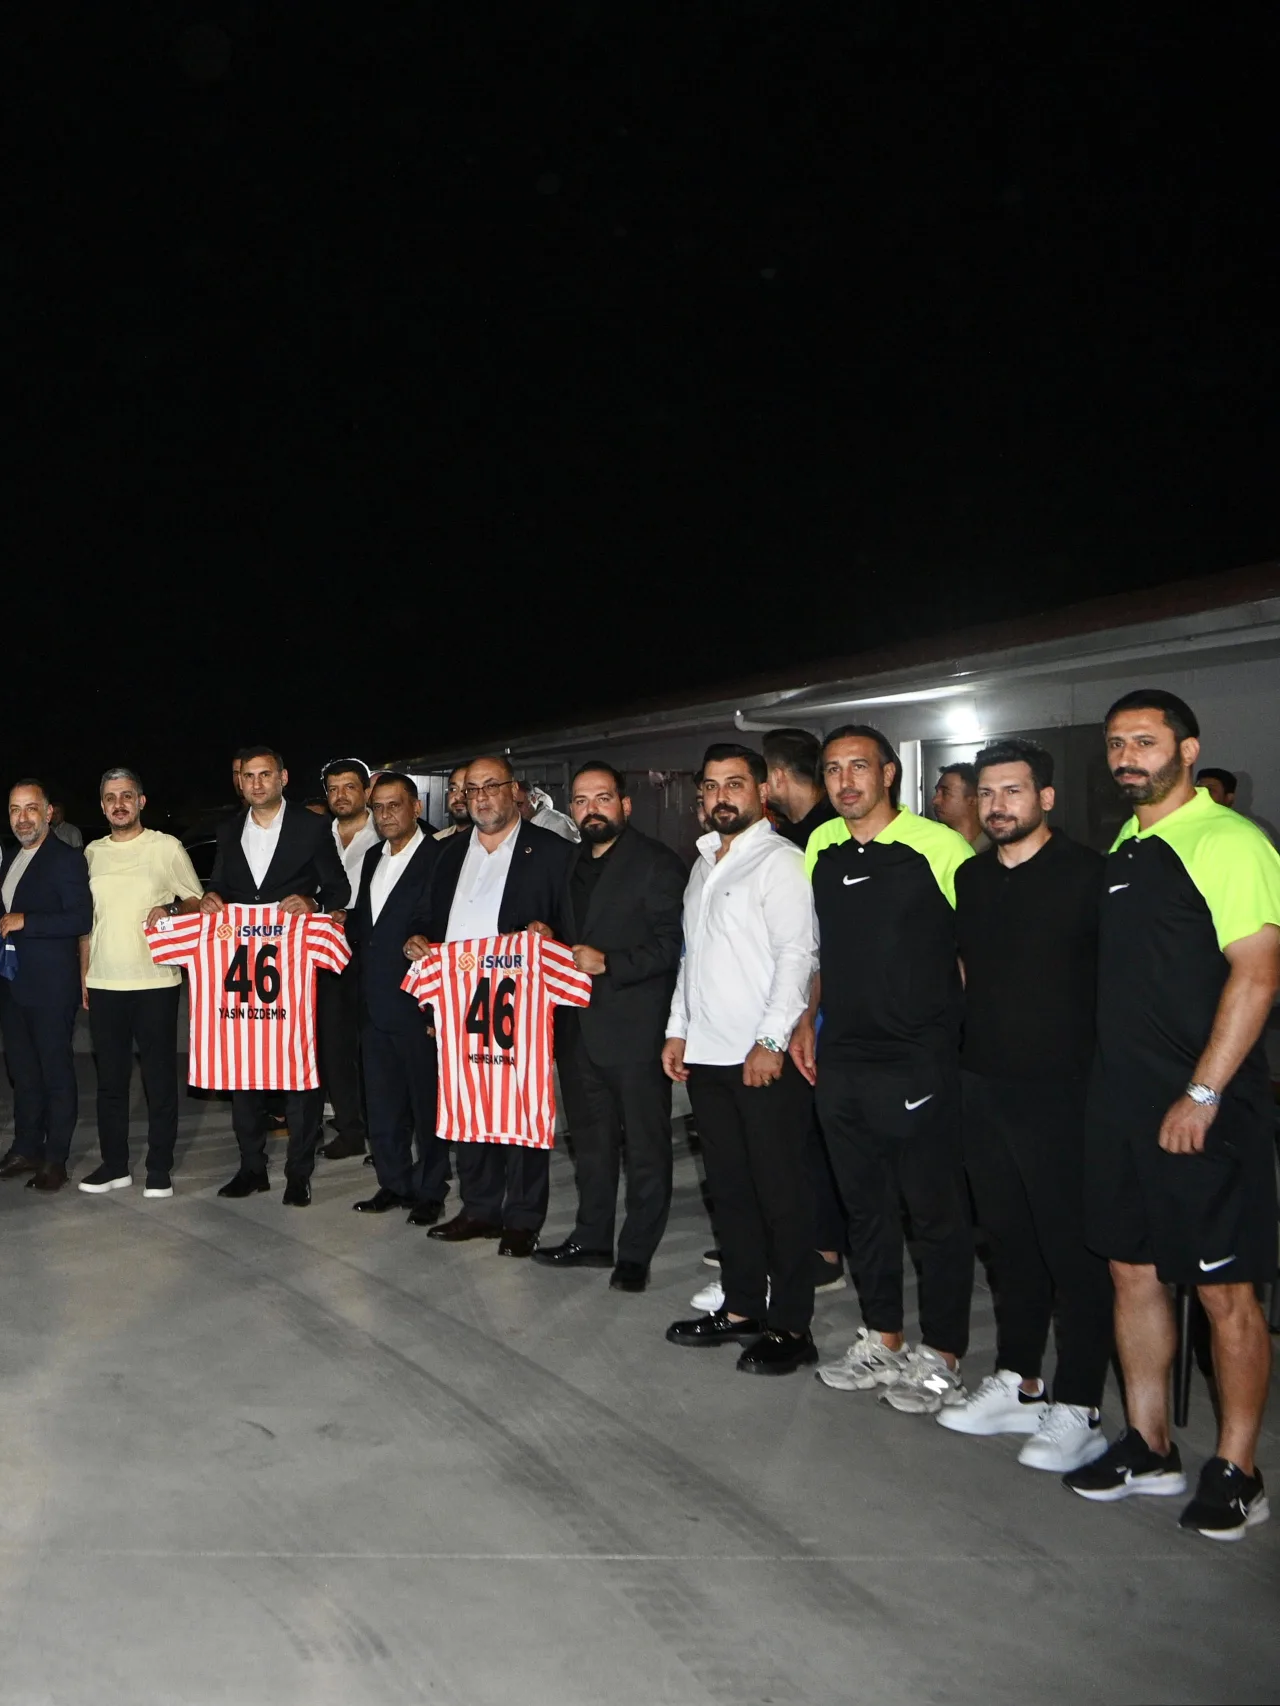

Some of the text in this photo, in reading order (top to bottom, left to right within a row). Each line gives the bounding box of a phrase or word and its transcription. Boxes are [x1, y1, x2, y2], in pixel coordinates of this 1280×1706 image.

[224, 944, 281, 1004] 46
[218, 1005, 287, 1020] YASİN ÖZDEMİR
[466, 976, 517, 1050] 46
